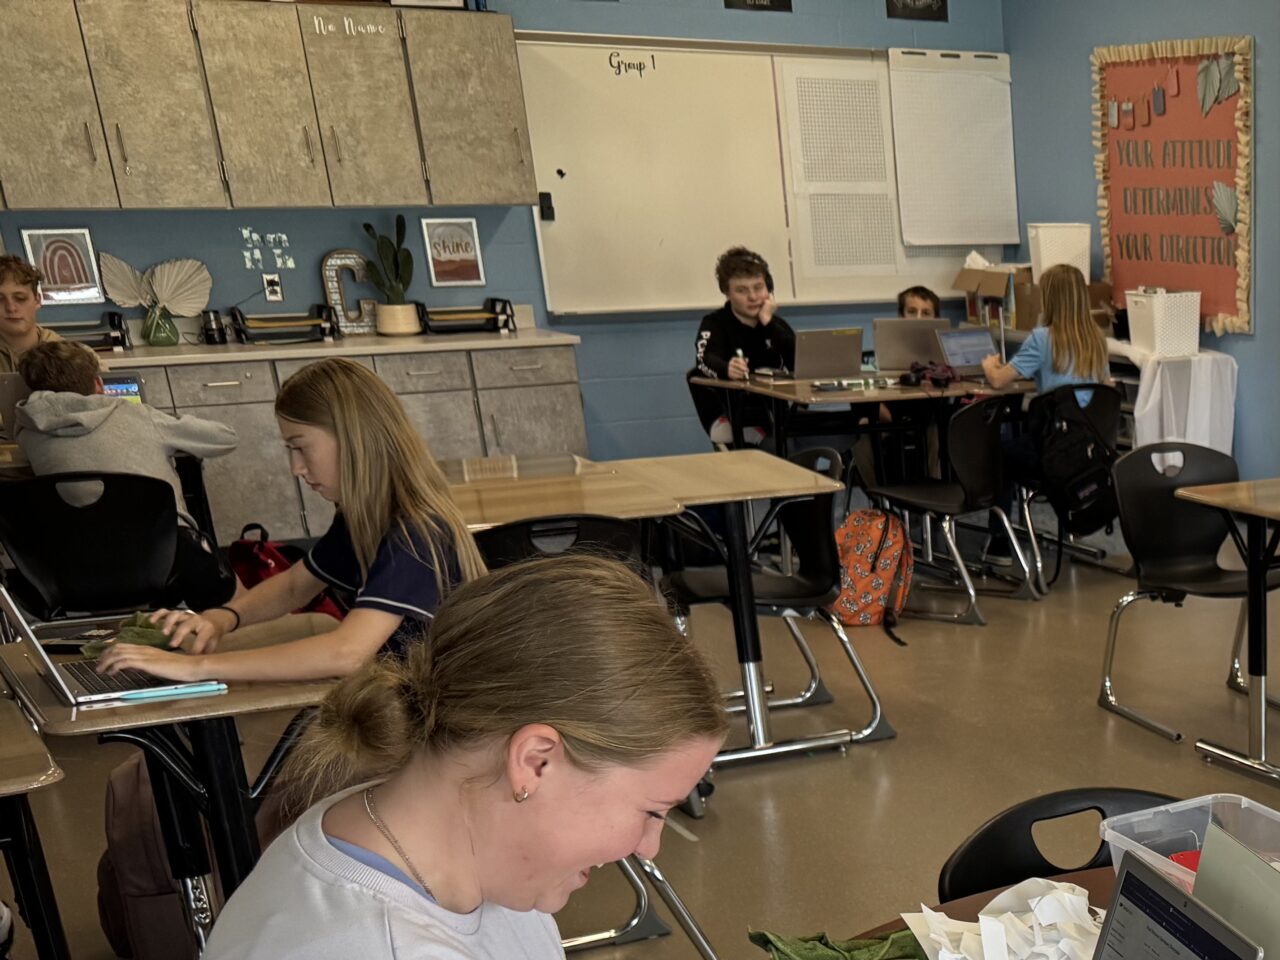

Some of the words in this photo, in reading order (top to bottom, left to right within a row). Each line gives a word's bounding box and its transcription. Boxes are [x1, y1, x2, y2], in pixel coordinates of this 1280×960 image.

[314, 16, 336, 36] No
[344, 16, 385, 36] Name
[608, 51, 646, 79] Group
[650, 54, 656, 71] 1
[1116, 139, 1154, 168] YOUR
[1123, 186, 1214, 216] DETERMINES
[432, 239, 474, 258] shine
[1116, 232, 1153, 262] YOUR
